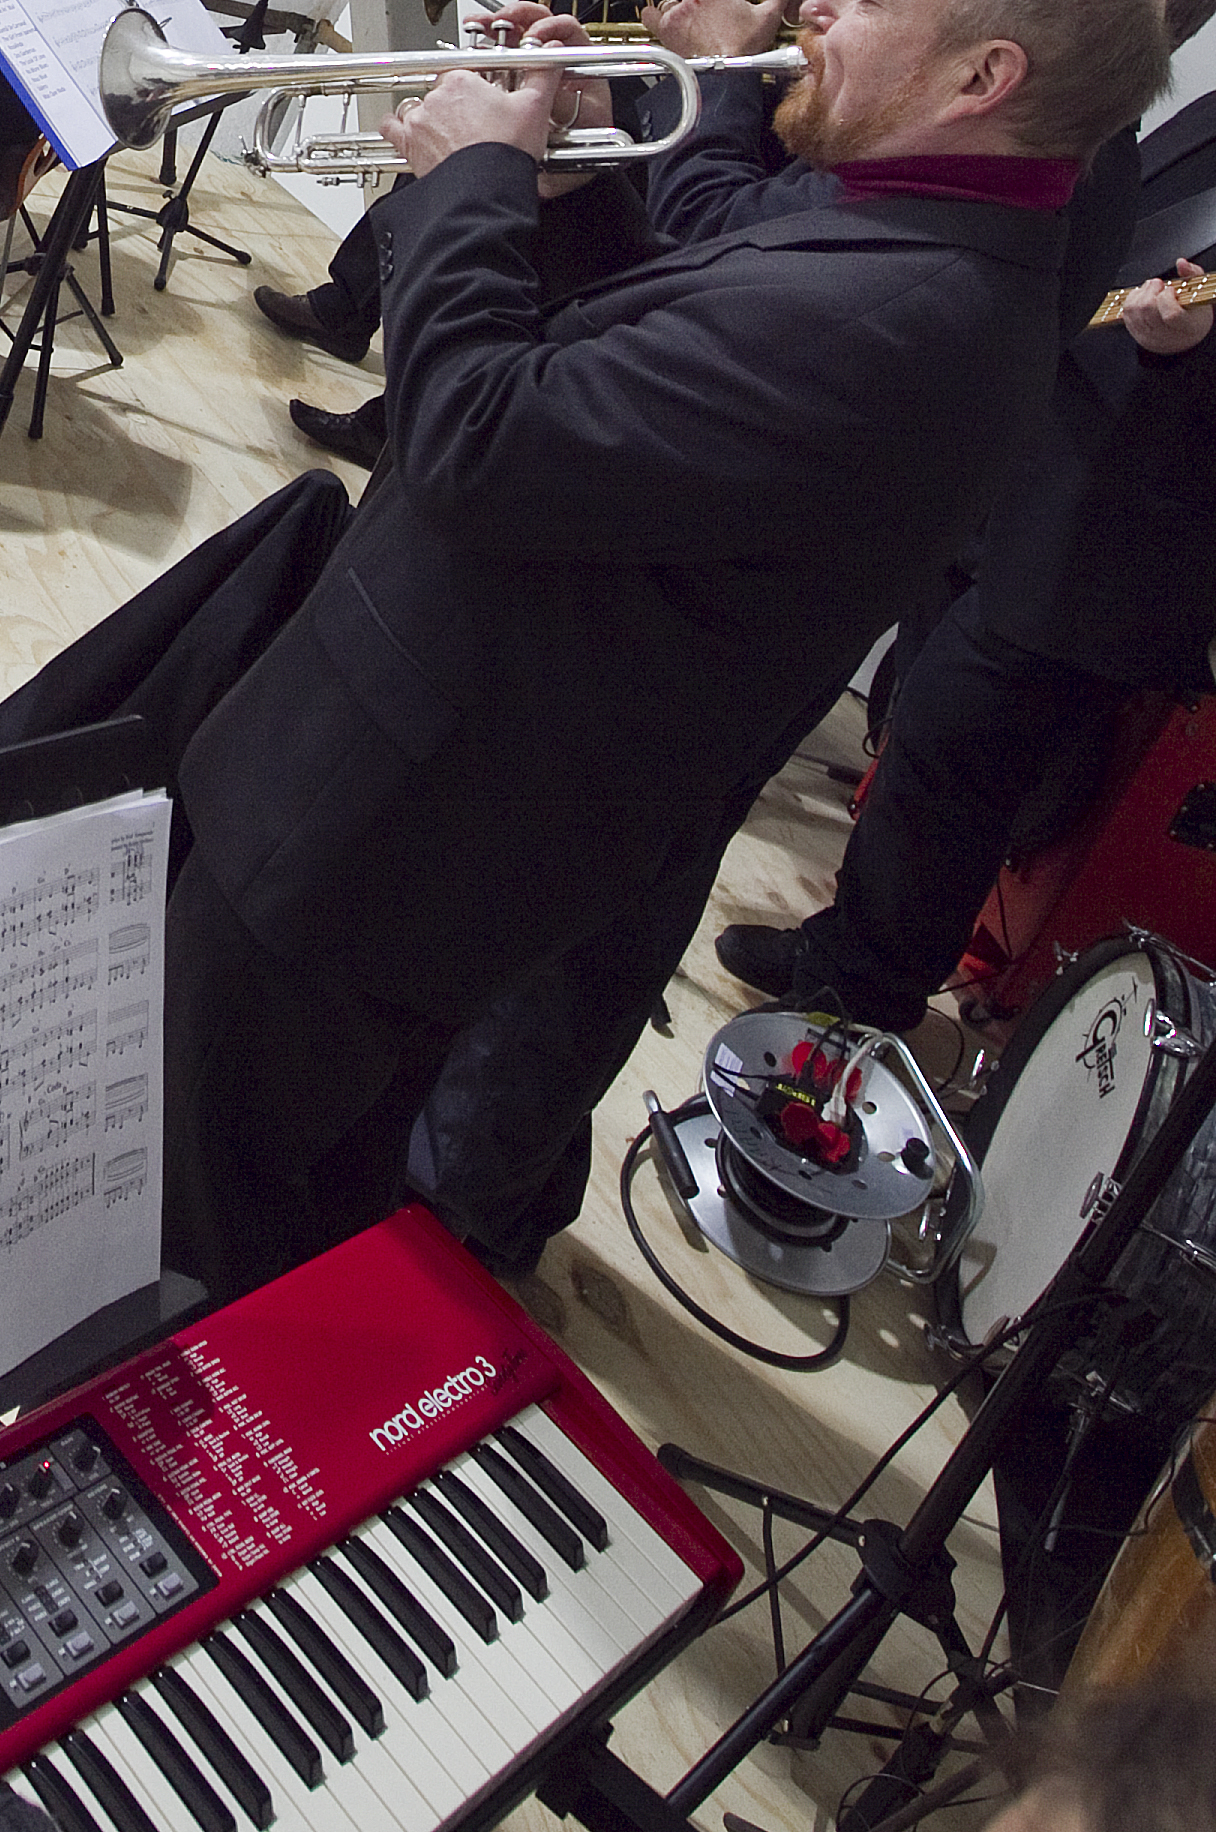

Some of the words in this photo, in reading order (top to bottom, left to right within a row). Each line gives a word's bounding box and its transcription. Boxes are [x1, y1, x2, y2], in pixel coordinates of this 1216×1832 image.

[1075, 1009, 1117, 1099] GRETSCH
[369, 1402, 425, 1451] nord
[418, 1367, 484, 1418] electro
[475, 1355, 496, 1377] 3
